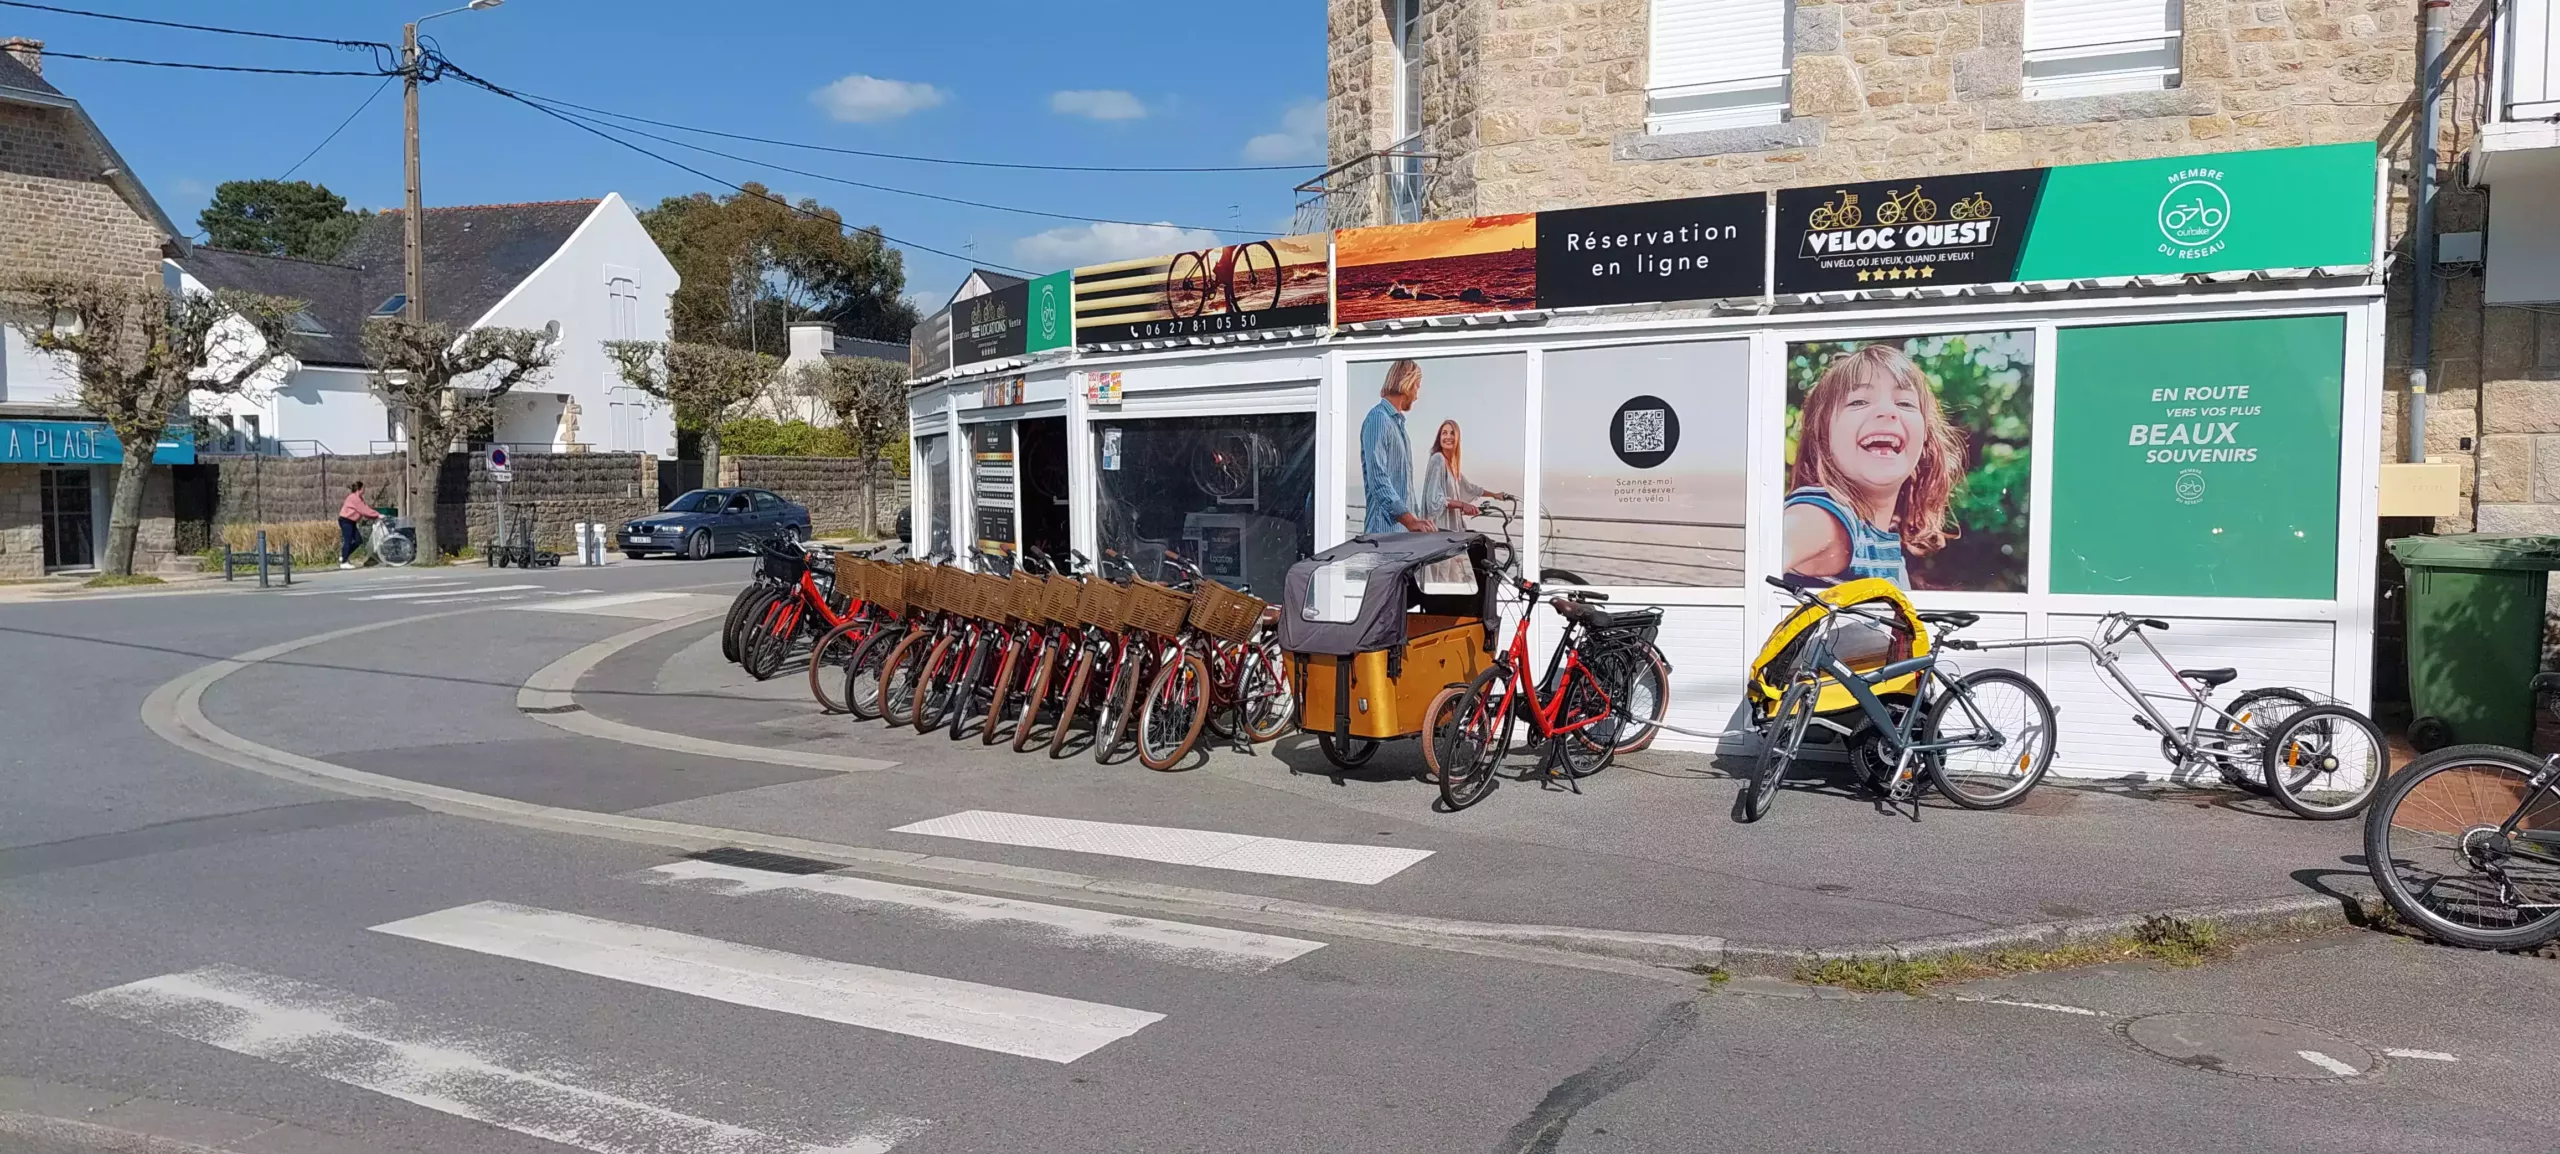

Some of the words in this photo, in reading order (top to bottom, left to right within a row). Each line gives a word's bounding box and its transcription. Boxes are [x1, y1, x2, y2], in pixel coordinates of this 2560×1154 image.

[2168, 168, 2225, 184] MEMBRE
[1567, 223, 1737, 252] Réservation
[2157, 243, 2176, 257] DU
[2178, 240, 2226, 260] RÉSEAU
[1592, 261, 1621, 276] en
[1637, 254, 1709, 277] ligne
[1820, 260, 1833, 269] UN
[1833, 258, 1856, 268] VÉLO,
[1857, 258, 1870, 267] OÙ
[1870, 257, 1880, 267] JE
[1880, 256, 1904, 266] VEUX,
[1904, 253, 1936, 264] QUAND
[1936, 253, 1946, 262] JE
[1947, 252, 1970, 261] VEUX
[1008, 318, 1022, 328] Vente
[1146, 324, 1160, 336] 06
[1169, 321, 1183, 334] 27
[1193, 319, 1207, 332] 81
[1217, 317, 1231, 330] 05
[1241, 314, 1256, 327] 50
[953, 330, 970, 341] Location
[2151, 388, 2179, 402] EN
[2184, 385, 2250, 401] ROUTE
[2166, 408, 2197, 418] VERS
[2200, 407, 2227, 417] VOS
[2229, 406, 2262, 416] PLUS
[2128, 422, 2240, 446] BEAUX
[34, 428, 104, 460] PLAGE
[2145, 448, 2258, 464] SOUVENIRS
[1616, 477, 1673, 487] Scannez-moi
[1614, 488, 1635, 496] pour
[1638, 486, 1675, 494] réserver
[1618, 495, 1642, 503] votre
[1645, 494, 1664, 503] vélo
[1209, 553, 1233, 564] Location
